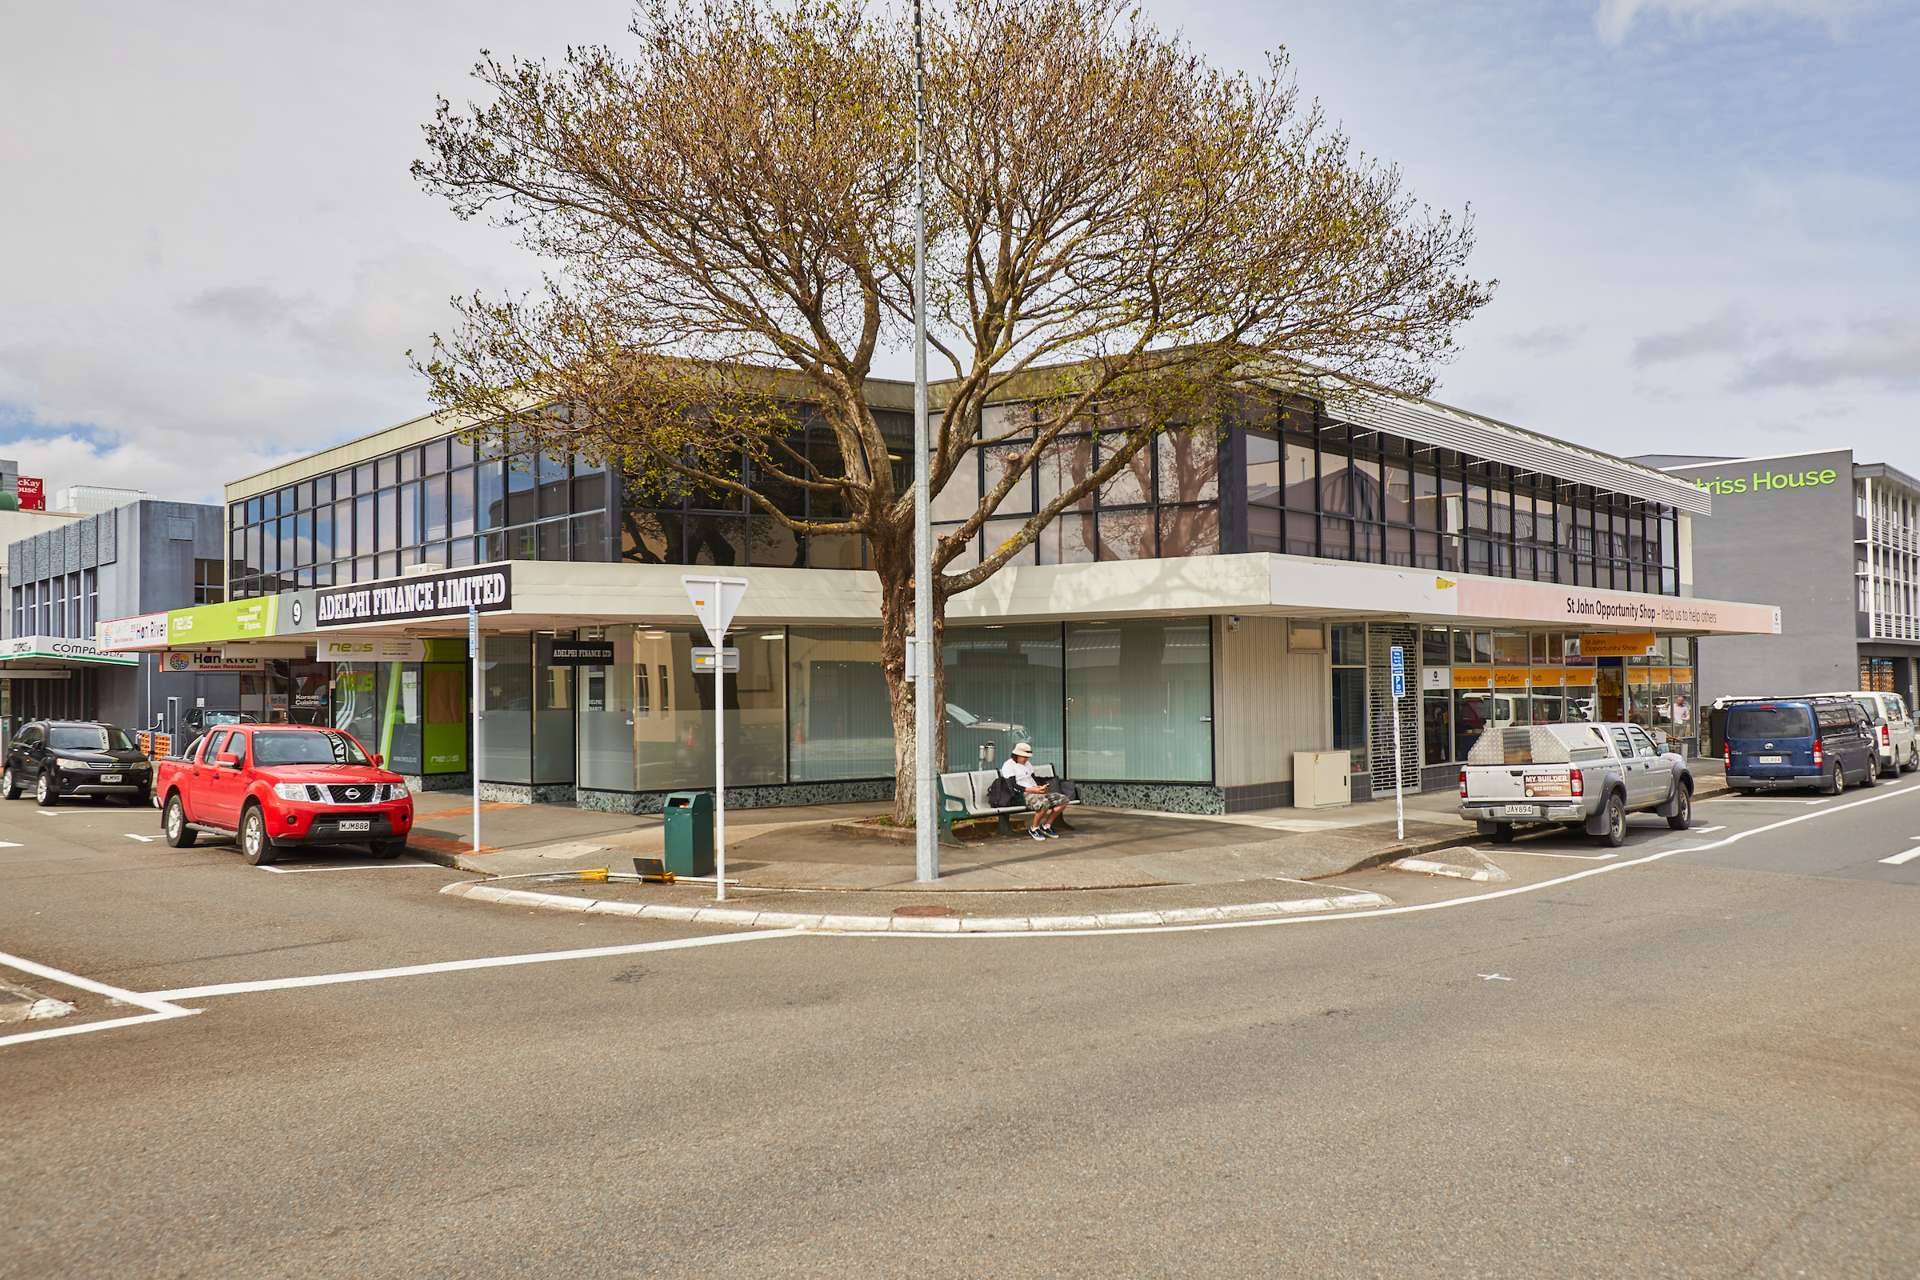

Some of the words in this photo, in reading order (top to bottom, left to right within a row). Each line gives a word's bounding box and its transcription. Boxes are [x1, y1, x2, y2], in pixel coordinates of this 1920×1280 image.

[1753, 468, 1837, 491] House
[318, 590, 371, 621] ADELPHI
[372, 582, 434, 616] FINANCE
[437, 573, 506, 609] LIMITED
[292, 603, 301, 622] 9
[1566, 597, 1575, 614] St
[1576, 598, 1594, 615] John
[1596, 600, 1639, 622] Opportunity
[1639, 604, 1656, 625] Shop
[1661, 607, 1675, 623] help
[1675, 611, 1682, 620] us
[1683, 609, 1688, 620] to
[1688, 608, 1701, 623] help
[1701, 610, 1717, 624] others
[193, 653, 222, 663] Han
[553, 649, 578, 657] ADELPHI
[579, 649, 601, 657] FINANCE
[1525, 775, 1536, 783] MY
